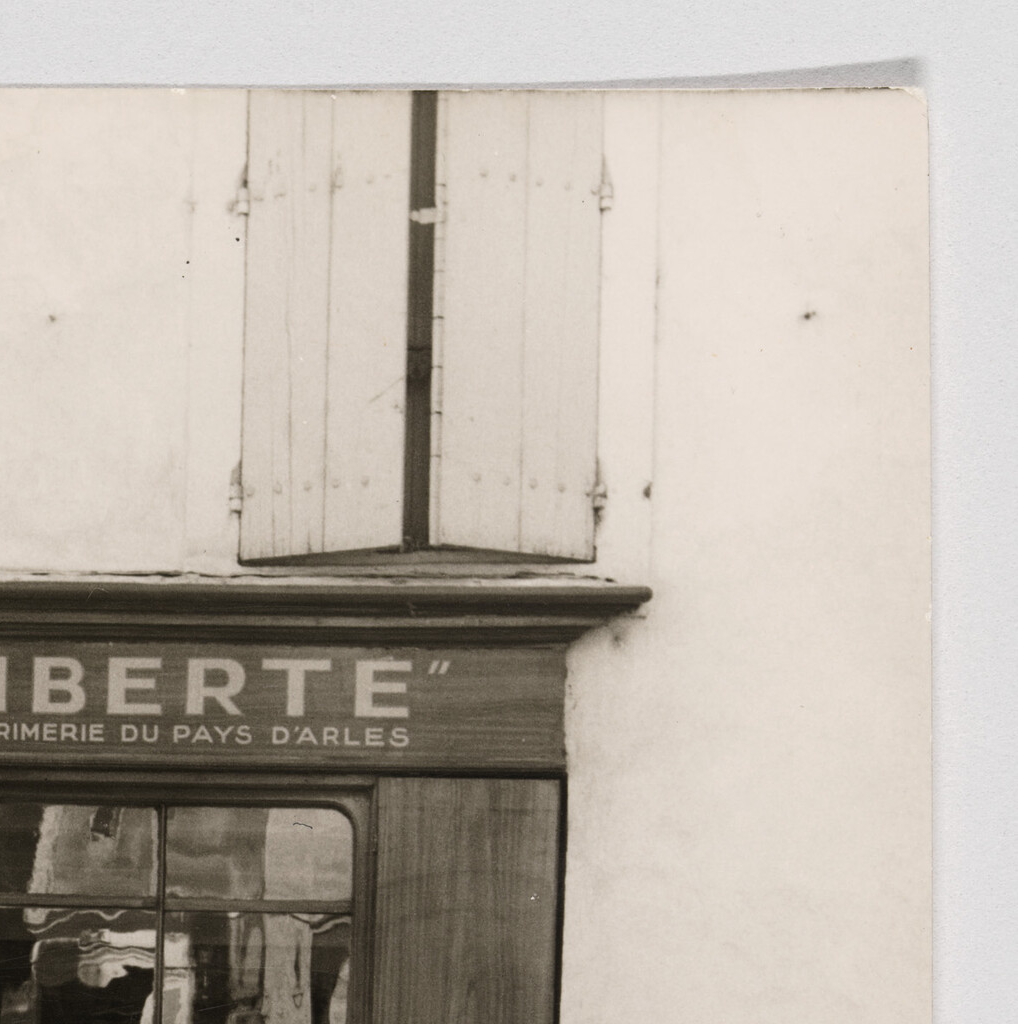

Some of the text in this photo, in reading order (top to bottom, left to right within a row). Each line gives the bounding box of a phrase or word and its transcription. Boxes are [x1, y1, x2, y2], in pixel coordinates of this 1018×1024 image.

[120, 725, 159, 743] DU
[172, 725, 253, 745] PAYS
[271, 726, 411, 748] D'ARLES
